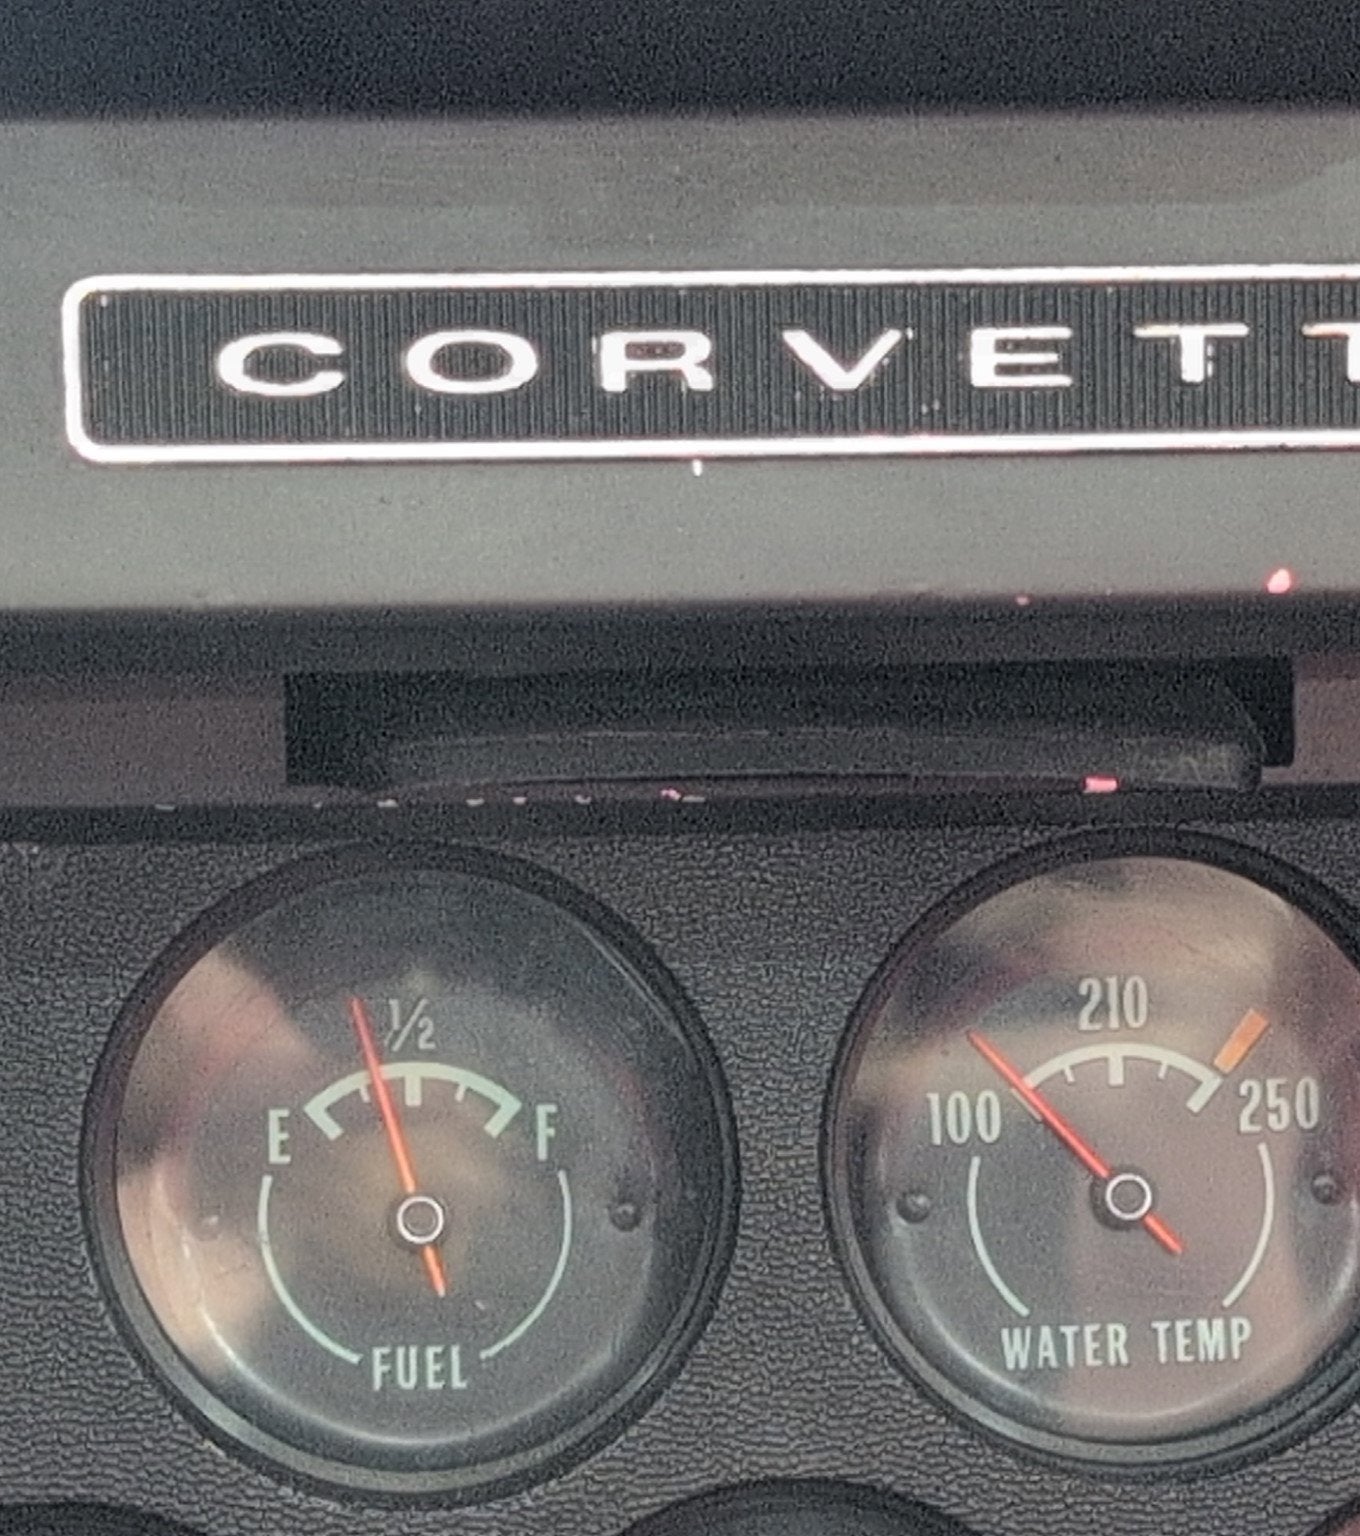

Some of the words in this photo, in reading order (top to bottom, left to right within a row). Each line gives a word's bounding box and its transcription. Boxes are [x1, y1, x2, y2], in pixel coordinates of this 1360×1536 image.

[1078, 975, 1149, 1030] 210
[537, 1105, 559, 1161] F
[926, 1089, 1002, 1146] 100
[1238, 1077, 1320, 1133] 250
[267, 1108, 292, 1165] E
[372, 1345, 468, 1392] FUEL
[1001, 1324, 1129, 1370] WATER
[1151, 1317, 1253, 1364] TEMP
